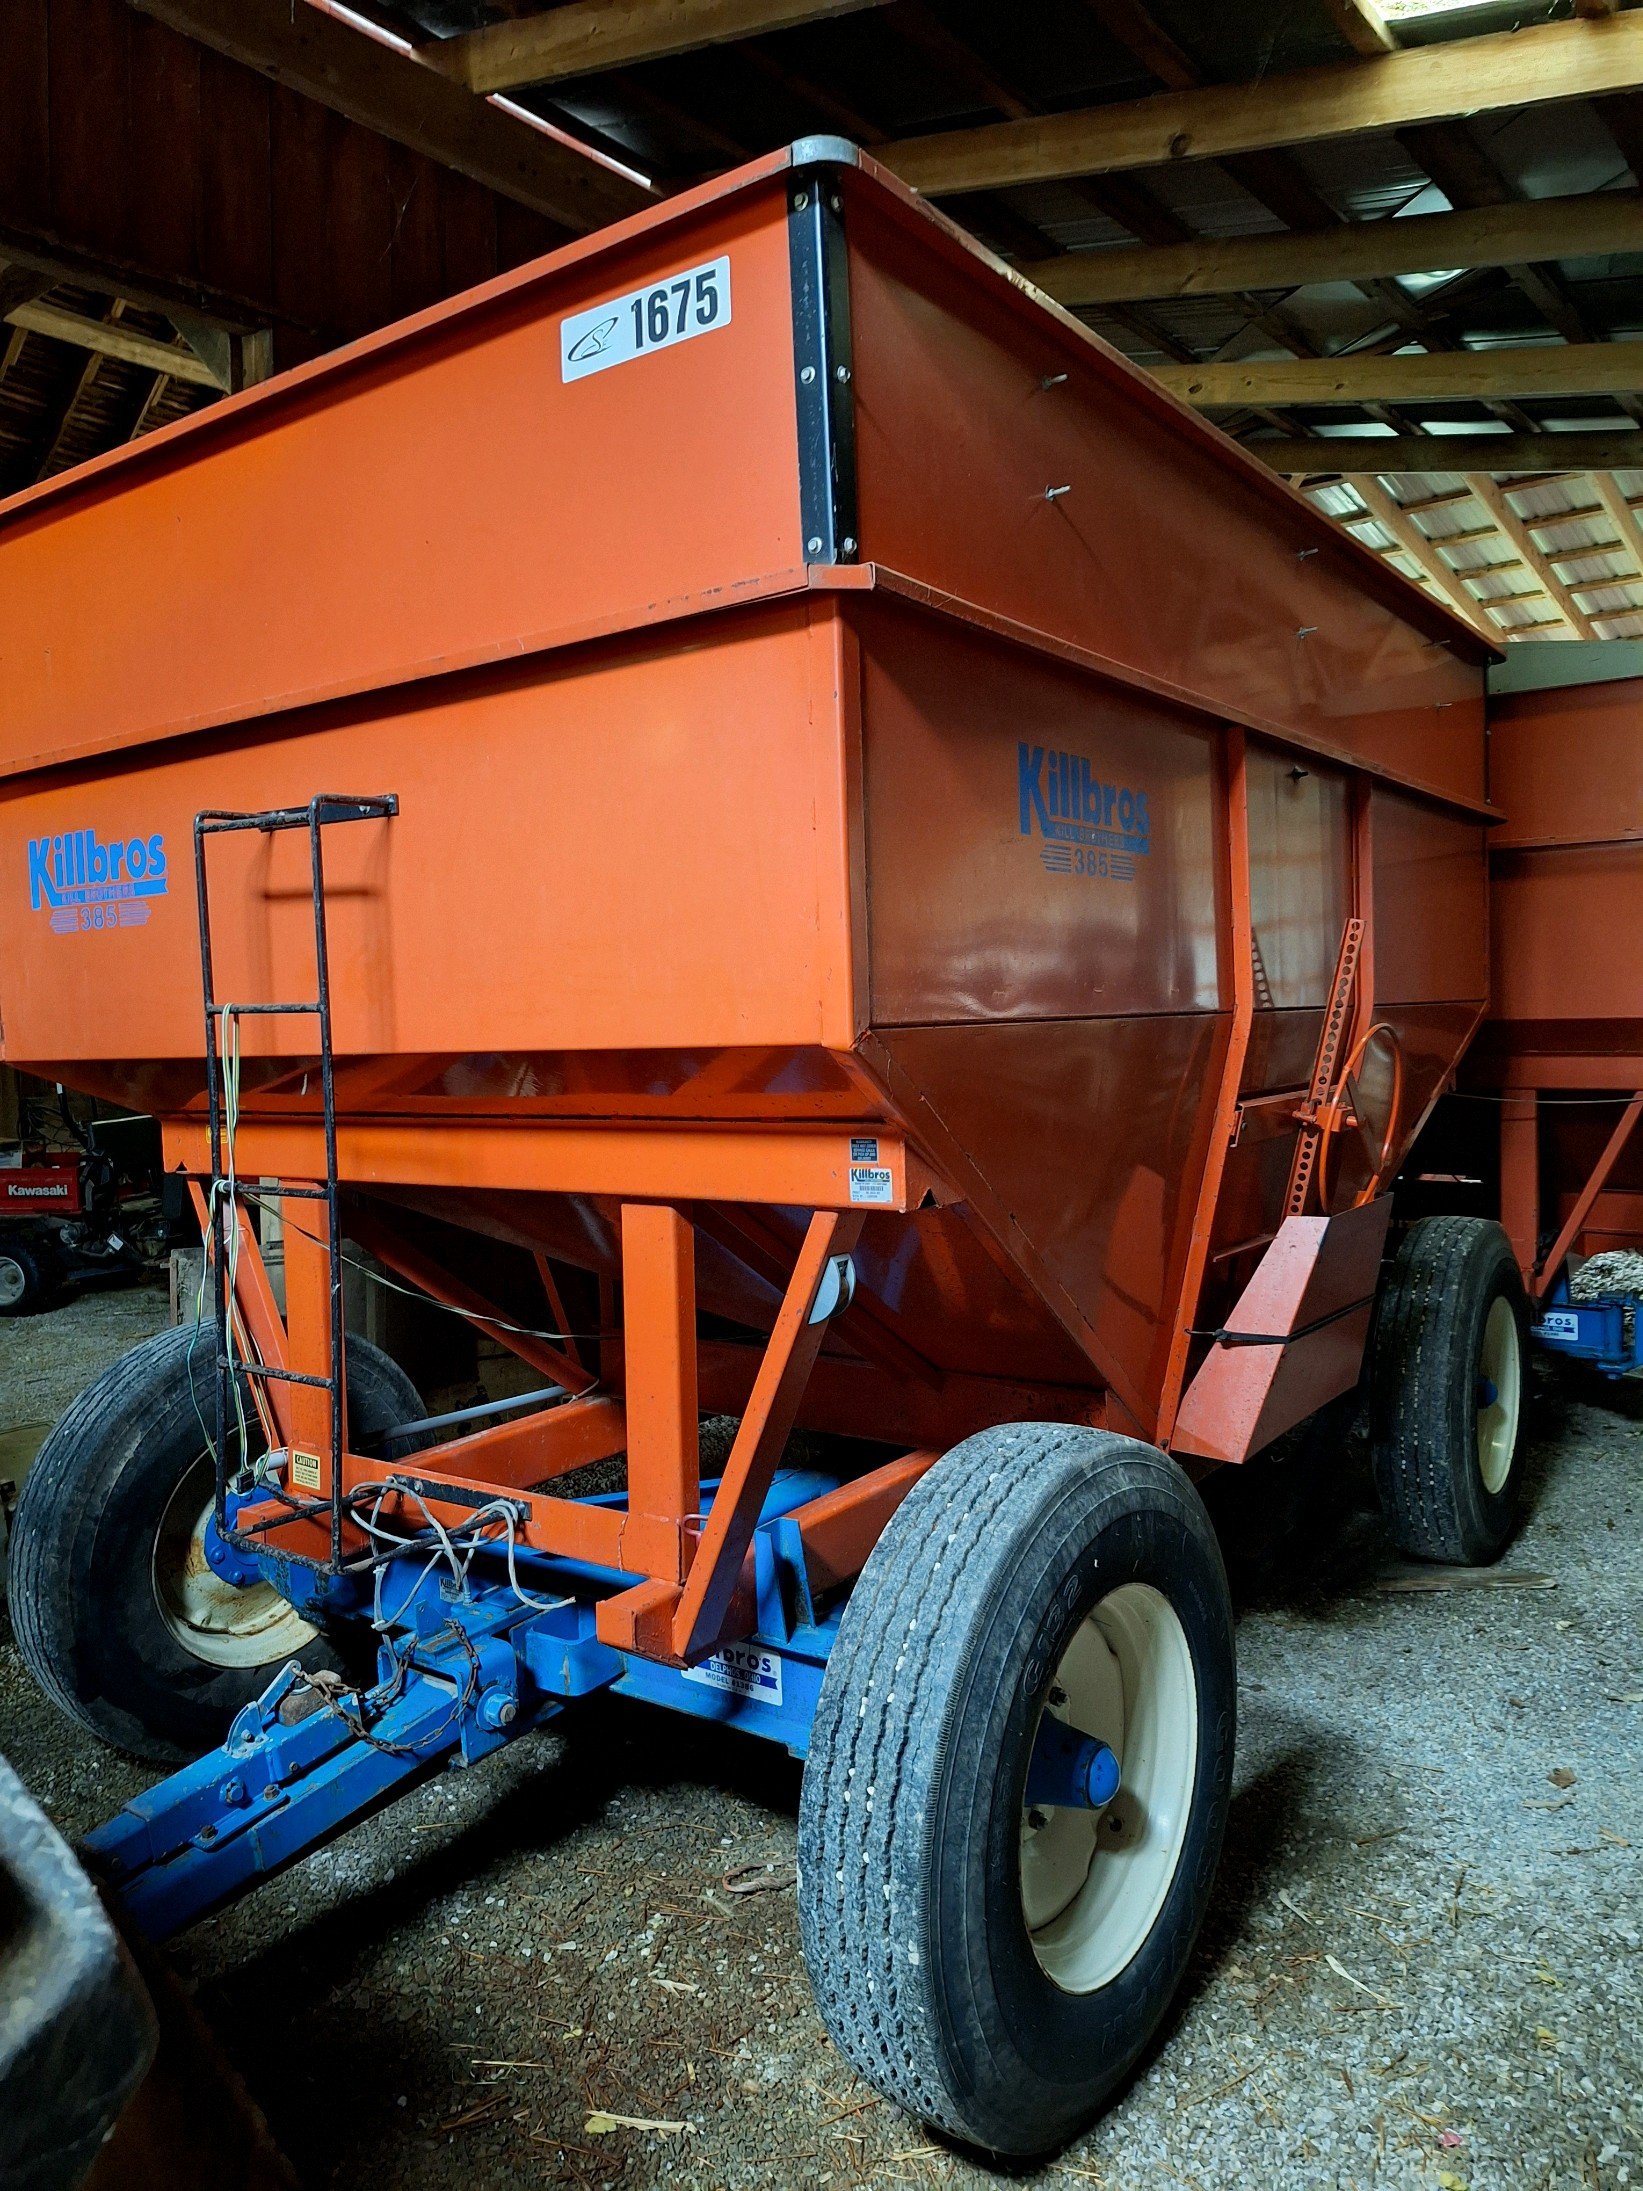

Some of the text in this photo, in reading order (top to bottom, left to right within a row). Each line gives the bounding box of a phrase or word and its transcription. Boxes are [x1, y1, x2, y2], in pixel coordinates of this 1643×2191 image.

[631, 269, 718, 349] 1675
[1018, 741, 1150, 836] Killbros
[28, 829, 166, 910] Killbros
[1074, 848, 1108, 877] 385
[80, 905, 118, 931] 385
[851, 1168, 890, 1182] Killbros
[8, 1185, 68, 1196] Kawasaki
[296, 1455, 317, 1468] CAUTION
[705, 1672, 730, 1685] MODEL
[744, 1671, 761, 1684] OHIO
